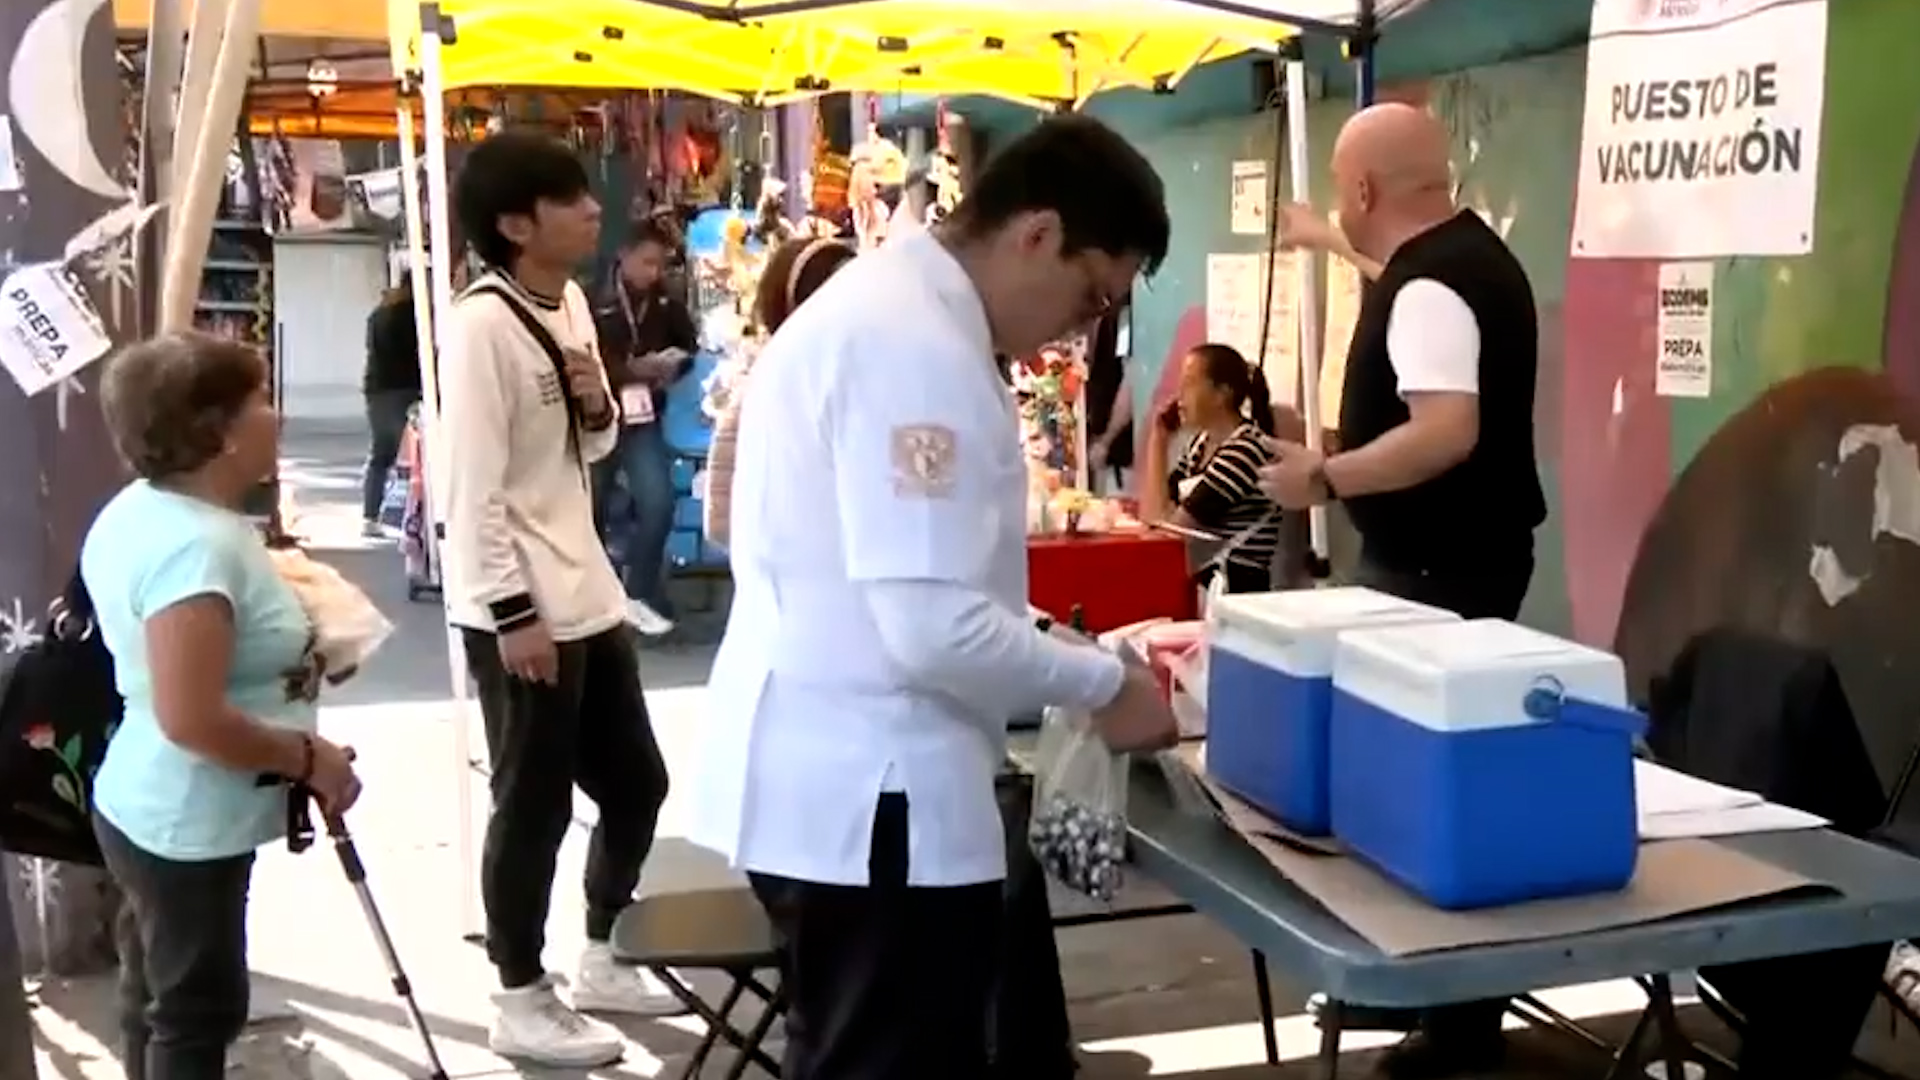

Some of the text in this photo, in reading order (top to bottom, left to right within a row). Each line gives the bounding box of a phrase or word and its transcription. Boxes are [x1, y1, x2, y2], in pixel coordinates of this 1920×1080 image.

[1611, 62, 1777, 124] PUESTO DE
[1597, 116, 1801, 184] VACUNACIÓN
[9, 287, 70, 361] PREPA
[1664, 339, 1703, 358] PREPA
